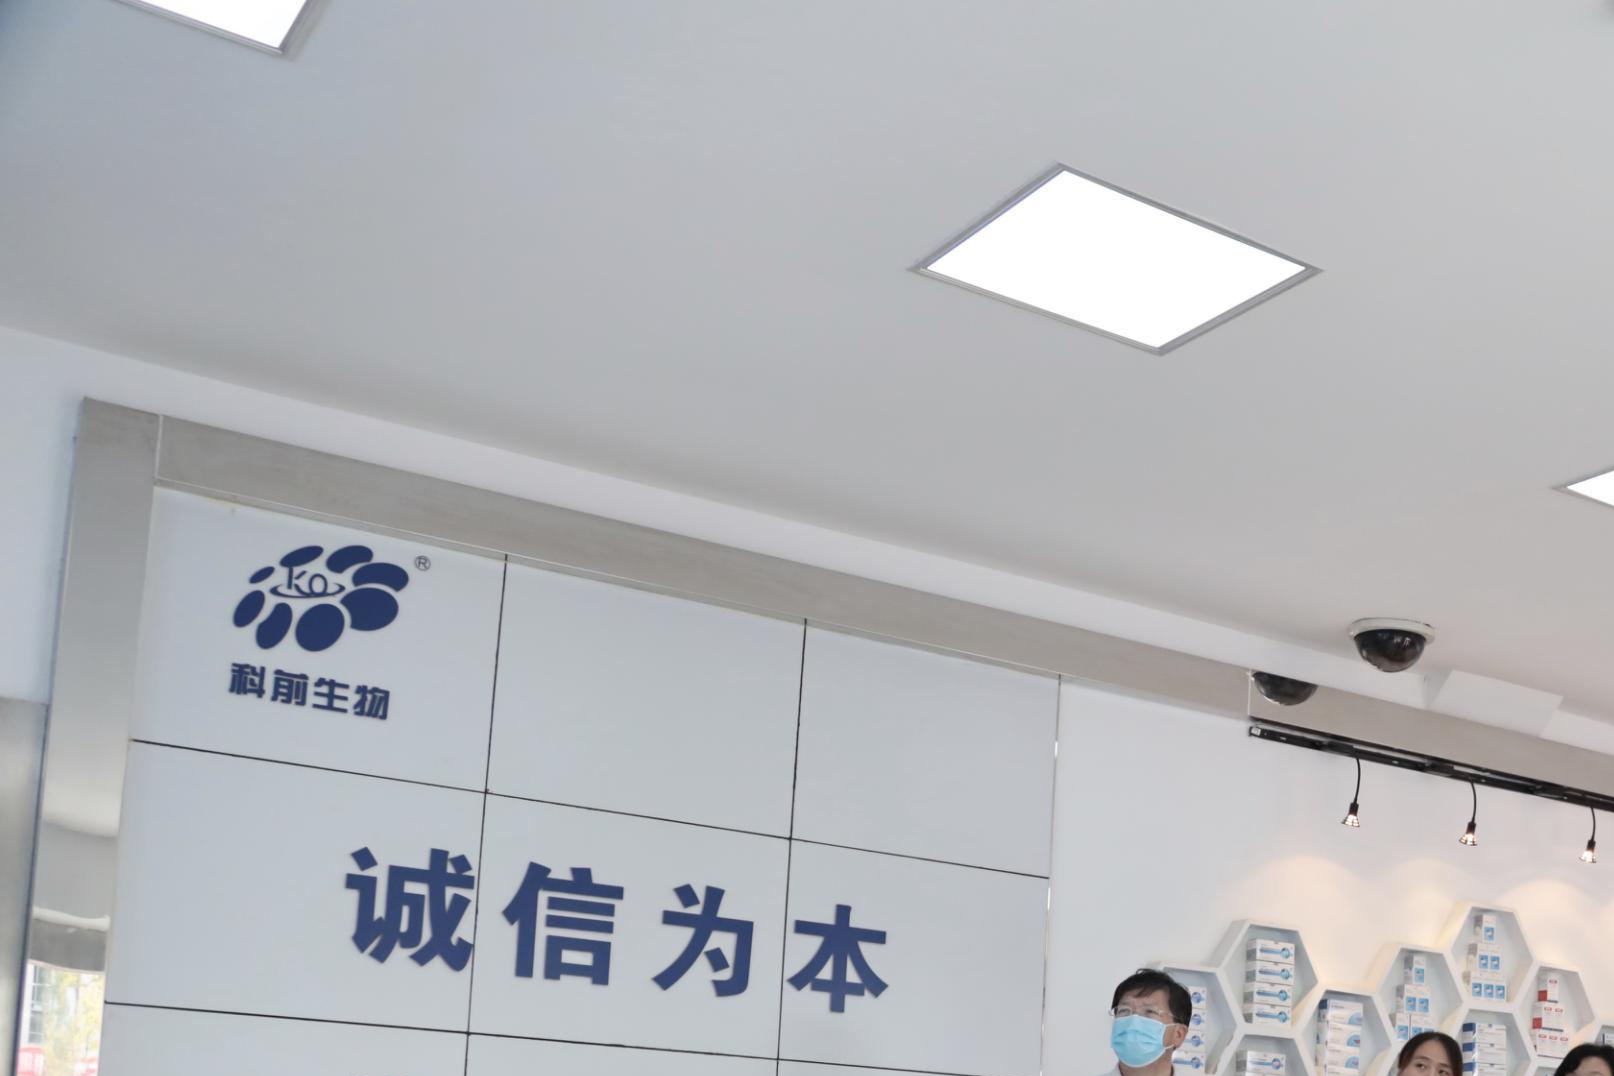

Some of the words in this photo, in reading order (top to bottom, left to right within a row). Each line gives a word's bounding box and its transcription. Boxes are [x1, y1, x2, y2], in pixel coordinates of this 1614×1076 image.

[228, 662, 391, 721] 科前生物
[345, 846, 889, 1013] 诚信为本
